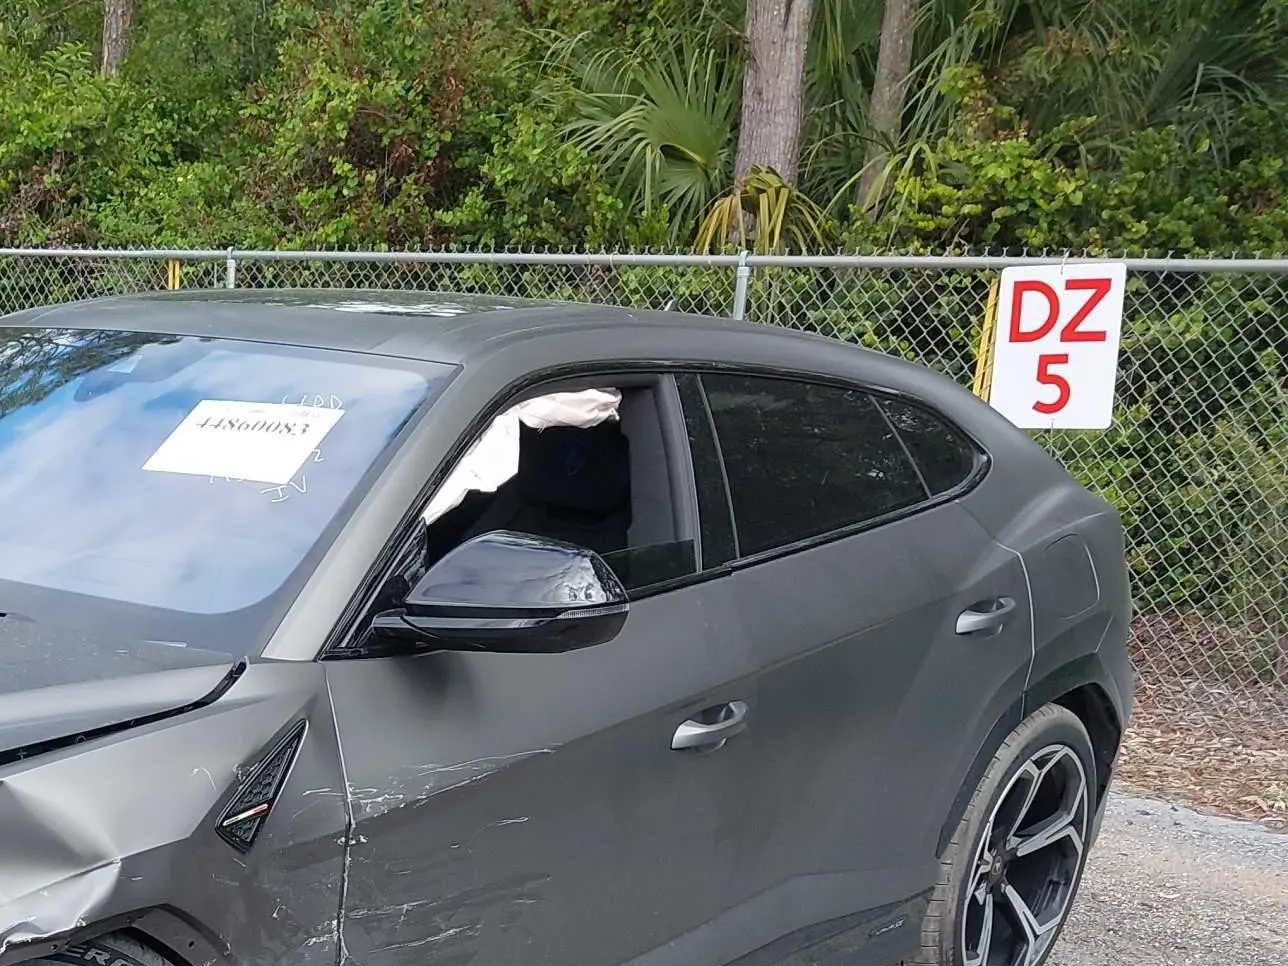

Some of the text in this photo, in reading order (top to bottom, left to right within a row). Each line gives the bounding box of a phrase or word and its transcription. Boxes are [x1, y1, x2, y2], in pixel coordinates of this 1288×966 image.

[1008, 277, 1113, 343] DZ
[1031, 353, 1072, 415] 5
[195, 416, 311, 436] 44860083
